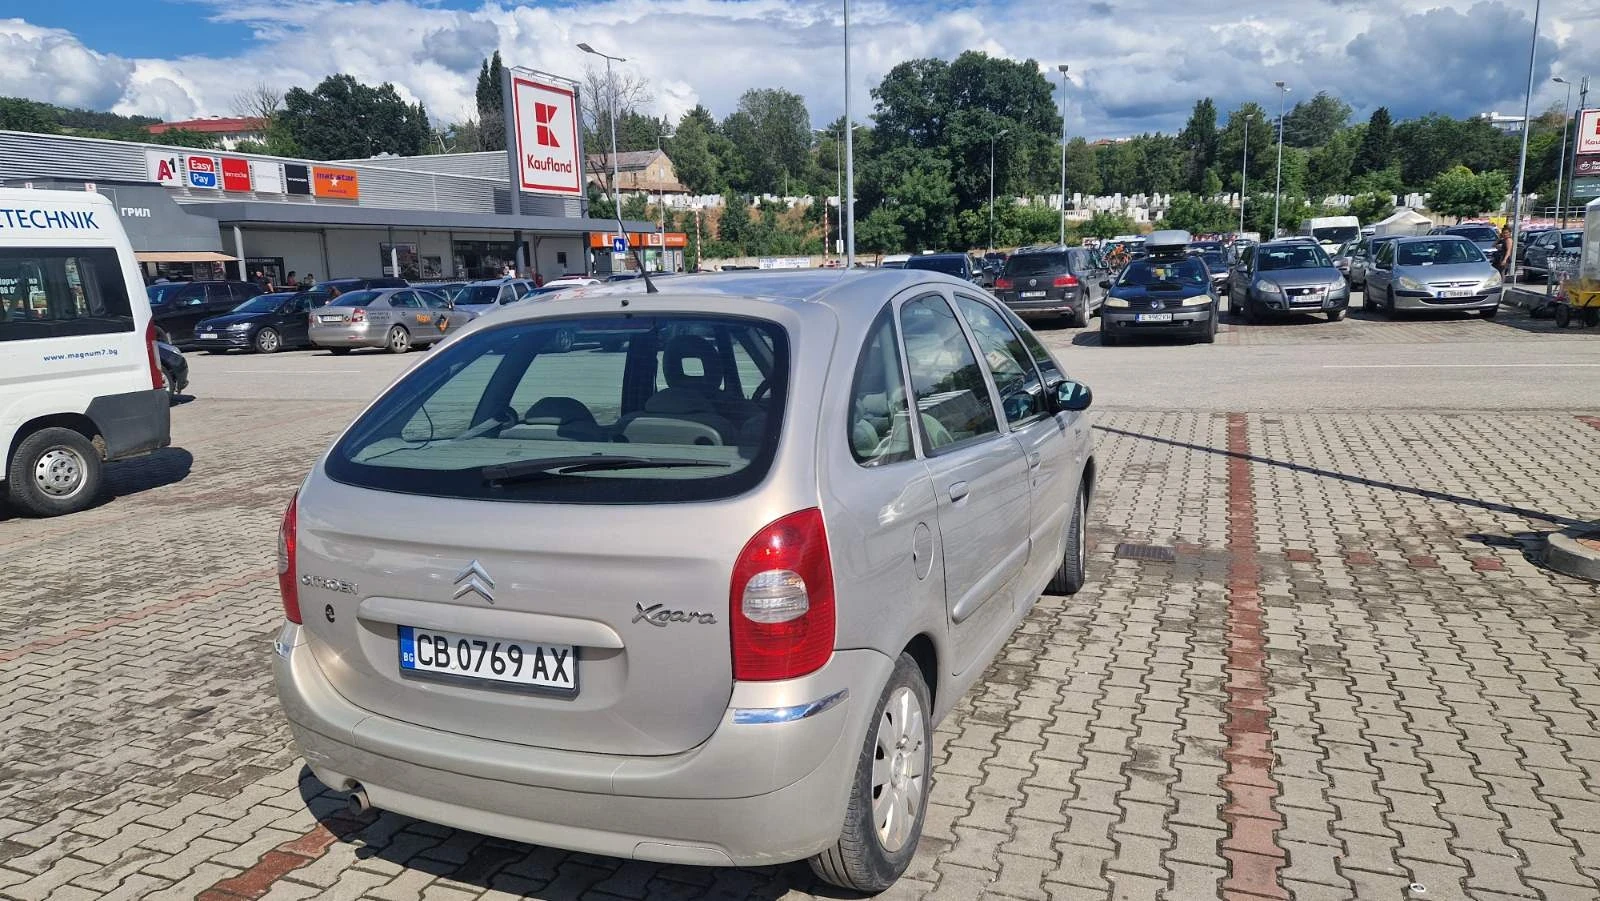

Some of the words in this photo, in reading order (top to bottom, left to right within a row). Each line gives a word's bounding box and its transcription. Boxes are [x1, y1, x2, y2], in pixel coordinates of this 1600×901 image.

[157, 157, 177, 181] A1
[191, 160, 211, 171] Easy
[527, 154, 572, 173] Kaufland
[193, 173, 209, 184] Pay
[0, 209, 99, 229] TECHNIK
[121, 207, 151, 218] ГРИЛ
[43, 348, 118, 361] www.magnum7.bg
[403, 651, 414, 663] BG
[417, 634, 451, 668] CB
[457, 639, 523, 678] 0769
[532, 646, 569, 683] AX
